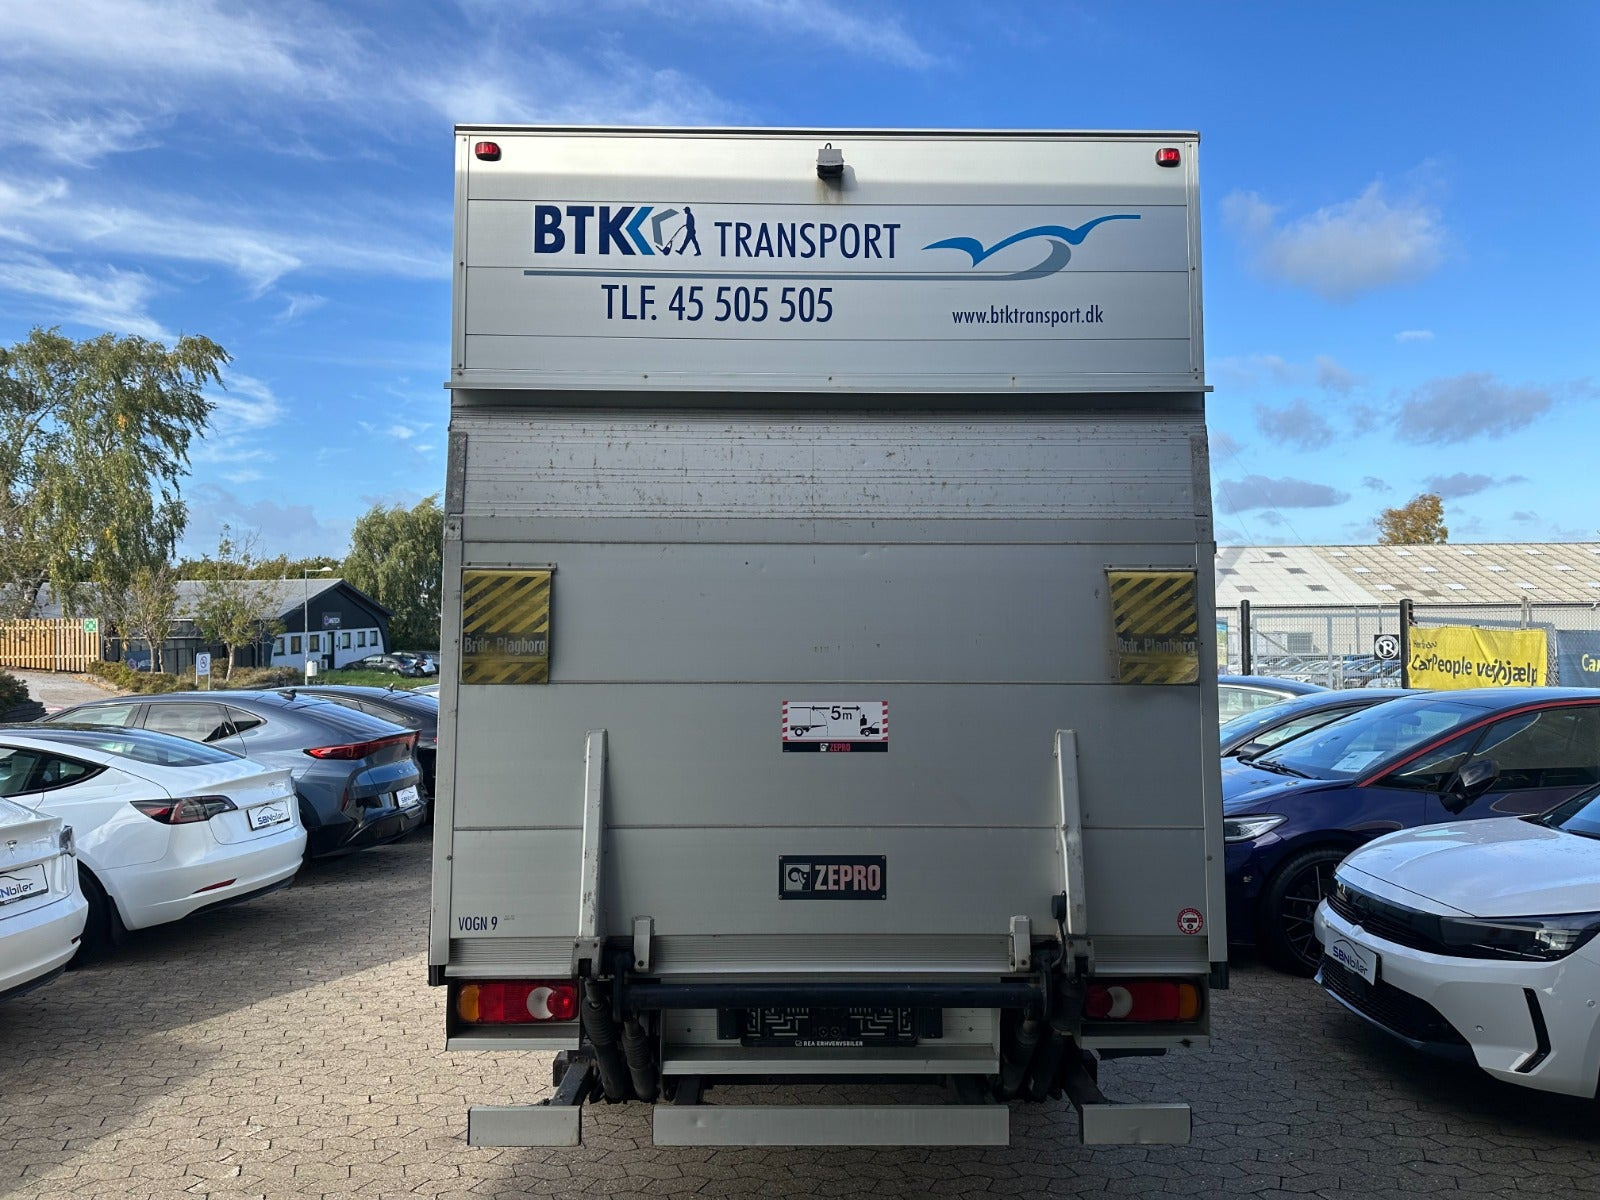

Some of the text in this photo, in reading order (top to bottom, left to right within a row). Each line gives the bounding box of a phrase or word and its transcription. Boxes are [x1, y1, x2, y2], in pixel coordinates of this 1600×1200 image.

[714, 222, 901, 259] TRANSPORT
[601, 284, 833, 323] TLF. 45 505 505
[952, 305, 1104, 327] www.btktransport.dk
[1411, 654, 1472, 679] CarPeople
[829, 743, 851, 752] ZEPRO
[814, 864, 881, 891] ZEPRO
[458, 916, 488, 931] VOGN
[491, 916, 498, 931] 9
[1332, 945, 1369, 975] SBNbiler
